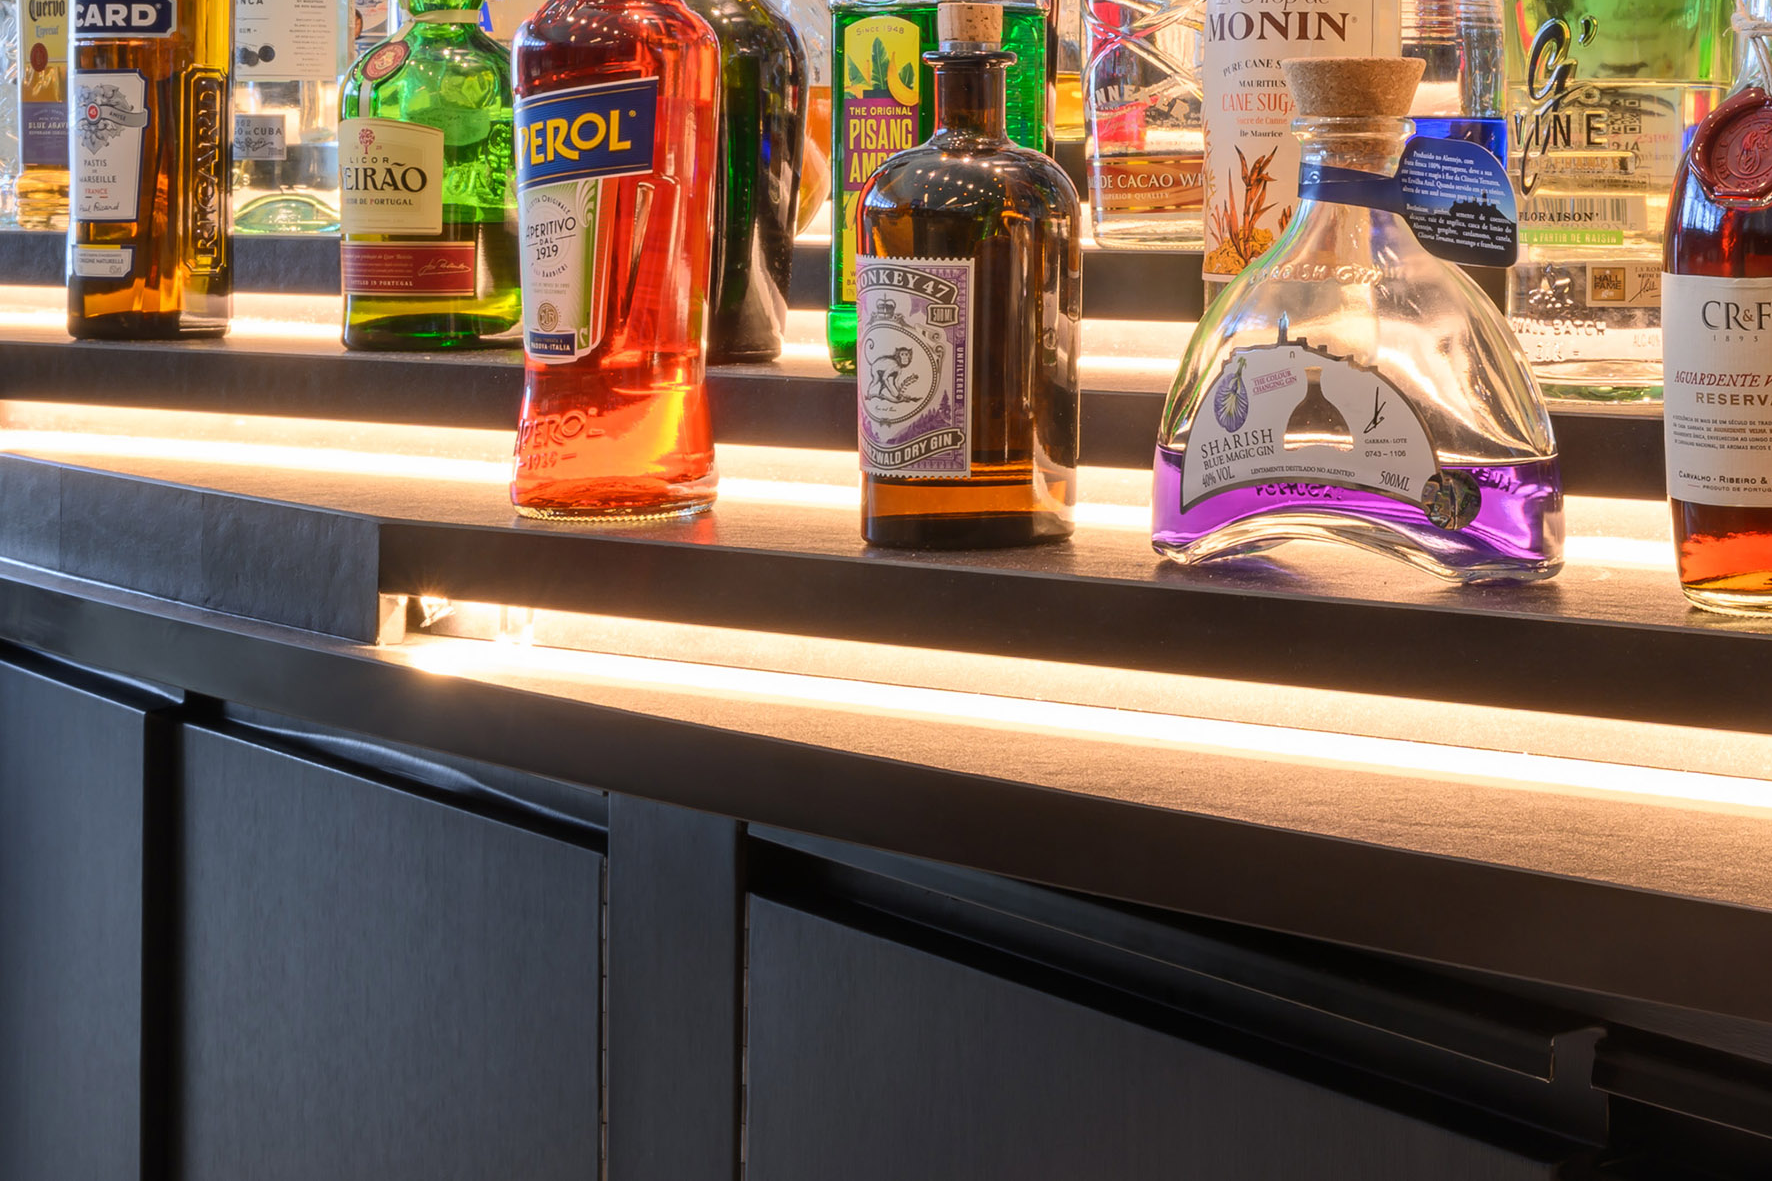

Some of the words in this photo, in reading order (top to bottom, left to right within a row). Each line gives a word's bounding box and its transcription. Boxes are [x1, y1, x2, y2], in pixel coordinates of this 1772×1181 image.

[1208, 11, 1349, 43] MONIN
[1244, 58, 1273, 69] CANE
[1238, 78, 1286, 88] MAURITIUS
[849, 107, 867, 115] THE
[870, 106, 912, 115] ORIGINAL
[1222, 93, 1252, 111] CANE
[254, 126, 282, 135] CUBA
[849, 118, 912, 150] PISANG
[1251, 130, 1283, 138] Maurice
[1515, 111, 1608, 148] VINE
[519, 109, 631, 169] PEROL
[84, 159, 107, 167] PASTIS
[350, 156, 390, 164] LICOR
[1117, 173, 1174, 188] CACAO
[370, 198, 414, 206] PORTUGAL
[526, 216, 576, 239] APERITIVO
[536, 245, 558, 261] 1919
[858, 270, 917, 290] ONKEY
[922, 281, 950, 298] 47
[1701, 300, 1772, 331] CR&F
[956, 346, 965, 401] UNFILTERED
[1675, 371, 1762, 387] AGUARDENTE
[904, 442, 927, 459] DRY
[930, 433, 952, 452] GIN
[1201, 429, 1273, 459] SHARISH
[1203, 456, 1225, 469] BLUE
[1226, 451, 1254, 465] MAGIC
[1256, 445, 1274, 457] GIN
[1379, 470, 1410, 492] 500ML
[1678, 470, 1711, 482] CARVALHO
[1719, 476, 1756, 484] RIBEIRO
